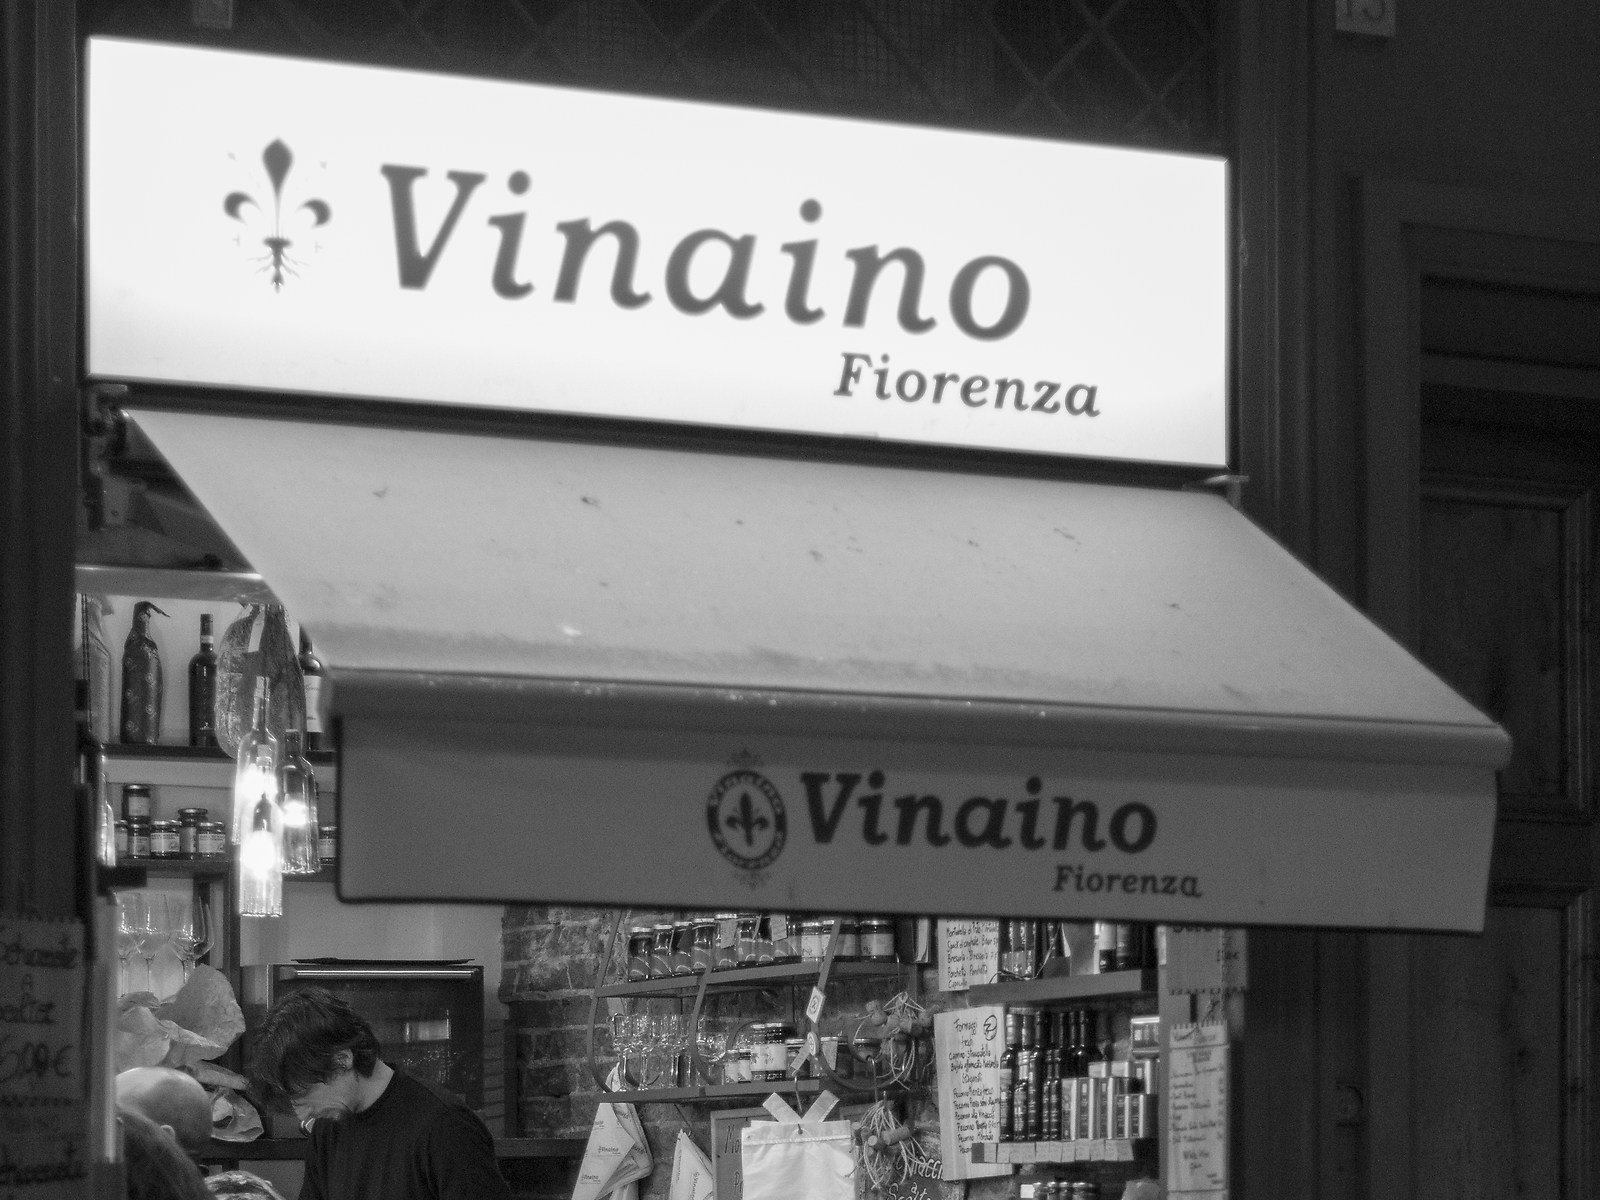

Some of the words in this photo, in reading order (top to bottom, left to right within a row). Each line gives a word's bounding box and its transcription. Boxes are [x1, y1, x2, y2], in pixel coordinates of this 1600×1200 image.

[380, 163, 1032, 341] Vinaino
[833, 352, 1102, 418] Fiorenza
[800, 770, 1158, 854] Vinaino
[1052, 864, 1203, 898] Fiorenza
